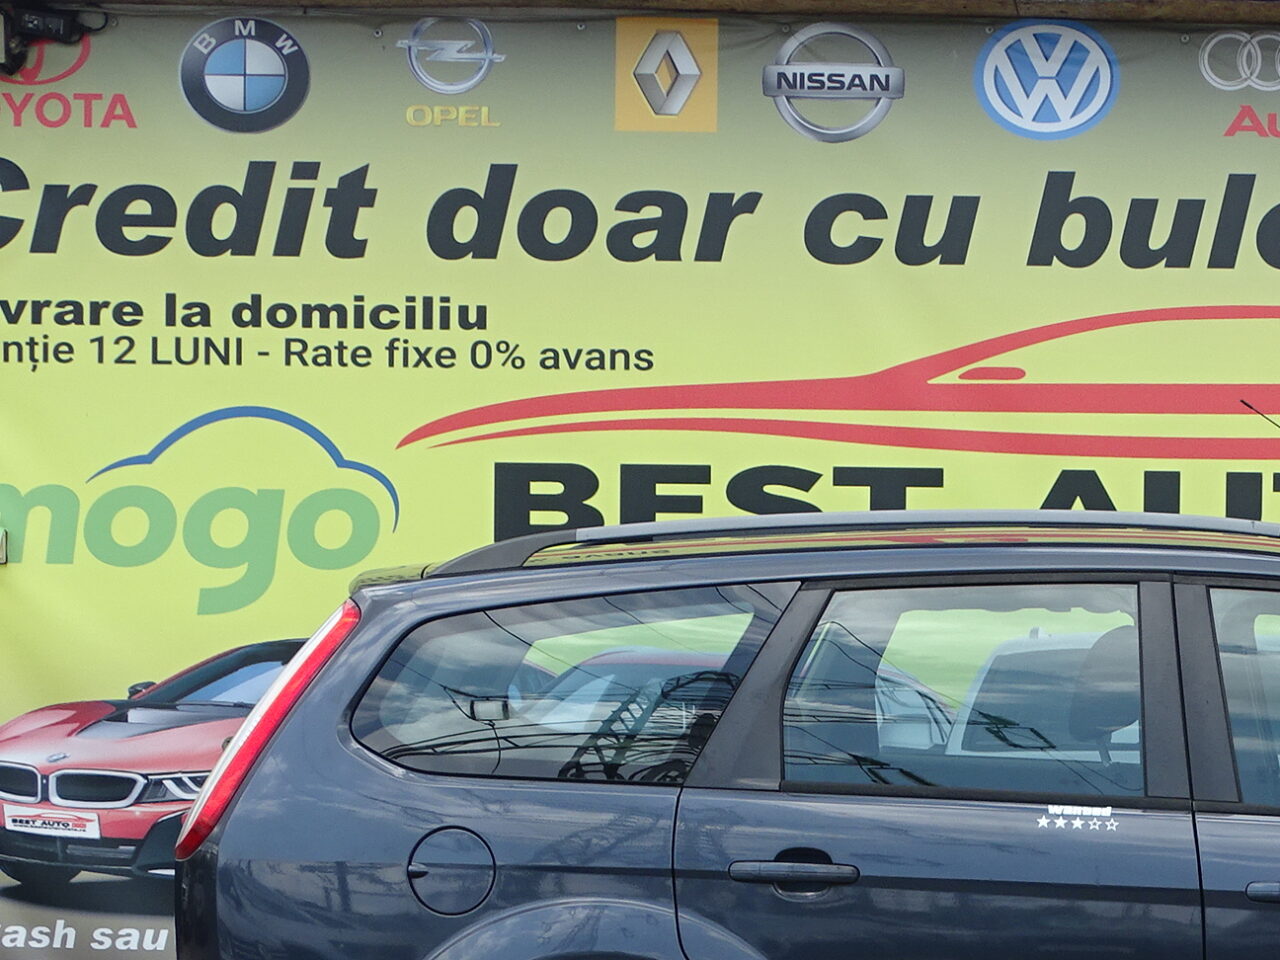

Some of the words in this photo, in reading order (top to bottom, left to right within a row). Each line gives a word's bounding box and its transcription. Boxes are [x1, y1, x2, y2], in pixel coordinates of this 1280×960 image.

[193, 20, 298, 55] BMW
[776, 71, 891, 92] NISSAN
[0, 91, 138, 128] YOTA
[405, 104, 501, 127] OPEL
[426, 164, 763, 263] doar
[804, 192, 981, 266] cu
[165, 293, 211, 327] la
[232, 294, 488, 331] domiciliu
[89, 336, 137, 364] 12
[151, 336, 243, 366] LUNI
[284, 338, 372, 369] Rate
[385, 338, 457, 369] fixe
[470, 340, 526, 370] 0%
[539, 348, 655, 371] avans
[493, 461, 944, 543] BEST
[0, 483, 380, 615] mogo
[0, 919, 76, 949] ash
[90, 927, 169, 950] sau
